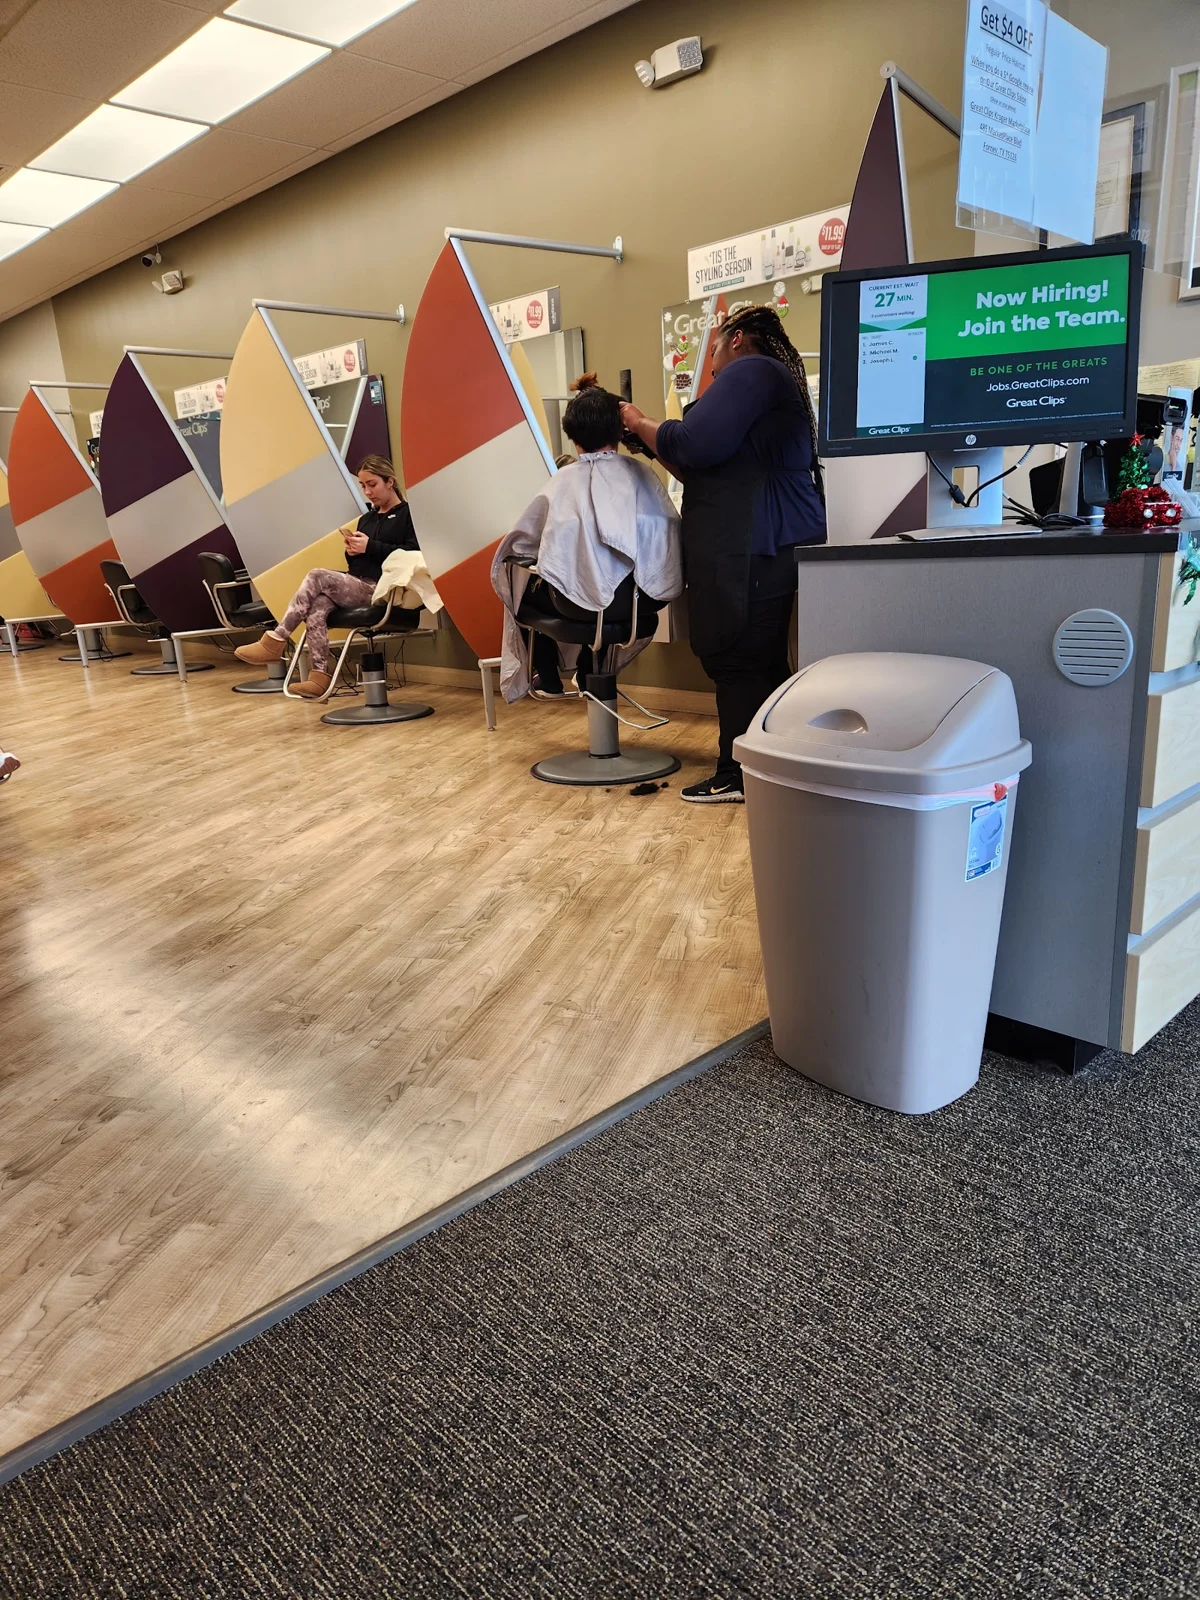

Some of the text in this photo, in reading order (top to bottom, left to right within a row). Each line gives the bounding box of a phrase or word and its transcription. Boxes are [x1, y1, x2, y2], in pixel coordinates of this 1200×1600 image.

[981, 5, 1033, 50] Get $4 OFF
[971, 55, 984, 68] When
[985, 63, 993, 73] you
[995, 82, 1006, 94] Great
[970, 101, 983, 113] Great
[984, 106, 993, 118] Clips
[994, 111, 1008, 124] Kroger
[999, 148, 1005, 156] TX
[822, 225, 844, 241] $11.99
[724, 245, 737, 261] THE
[695, 264, 723, 284] STYLING
[725, 256, 752, 276] SEASON
[875, 292, 913, 308] 27 MIN.
[976, 279, 1108, 309] Now Hiring!
[674, 310, 725, 335] Great
[958, 309, 1126, 337] Join the Team.
[970, 357, 1108, 376] BE ONE OF THE GREATS
[986, 376, 1090, 392] Jobs.GreatClips.com
[1006, 396, 1066, 408] Great Clips
[192, 422, 208, 436] Clips
[891, 426, 909, 434] Clips
[965, 434, 977, 446] hp
